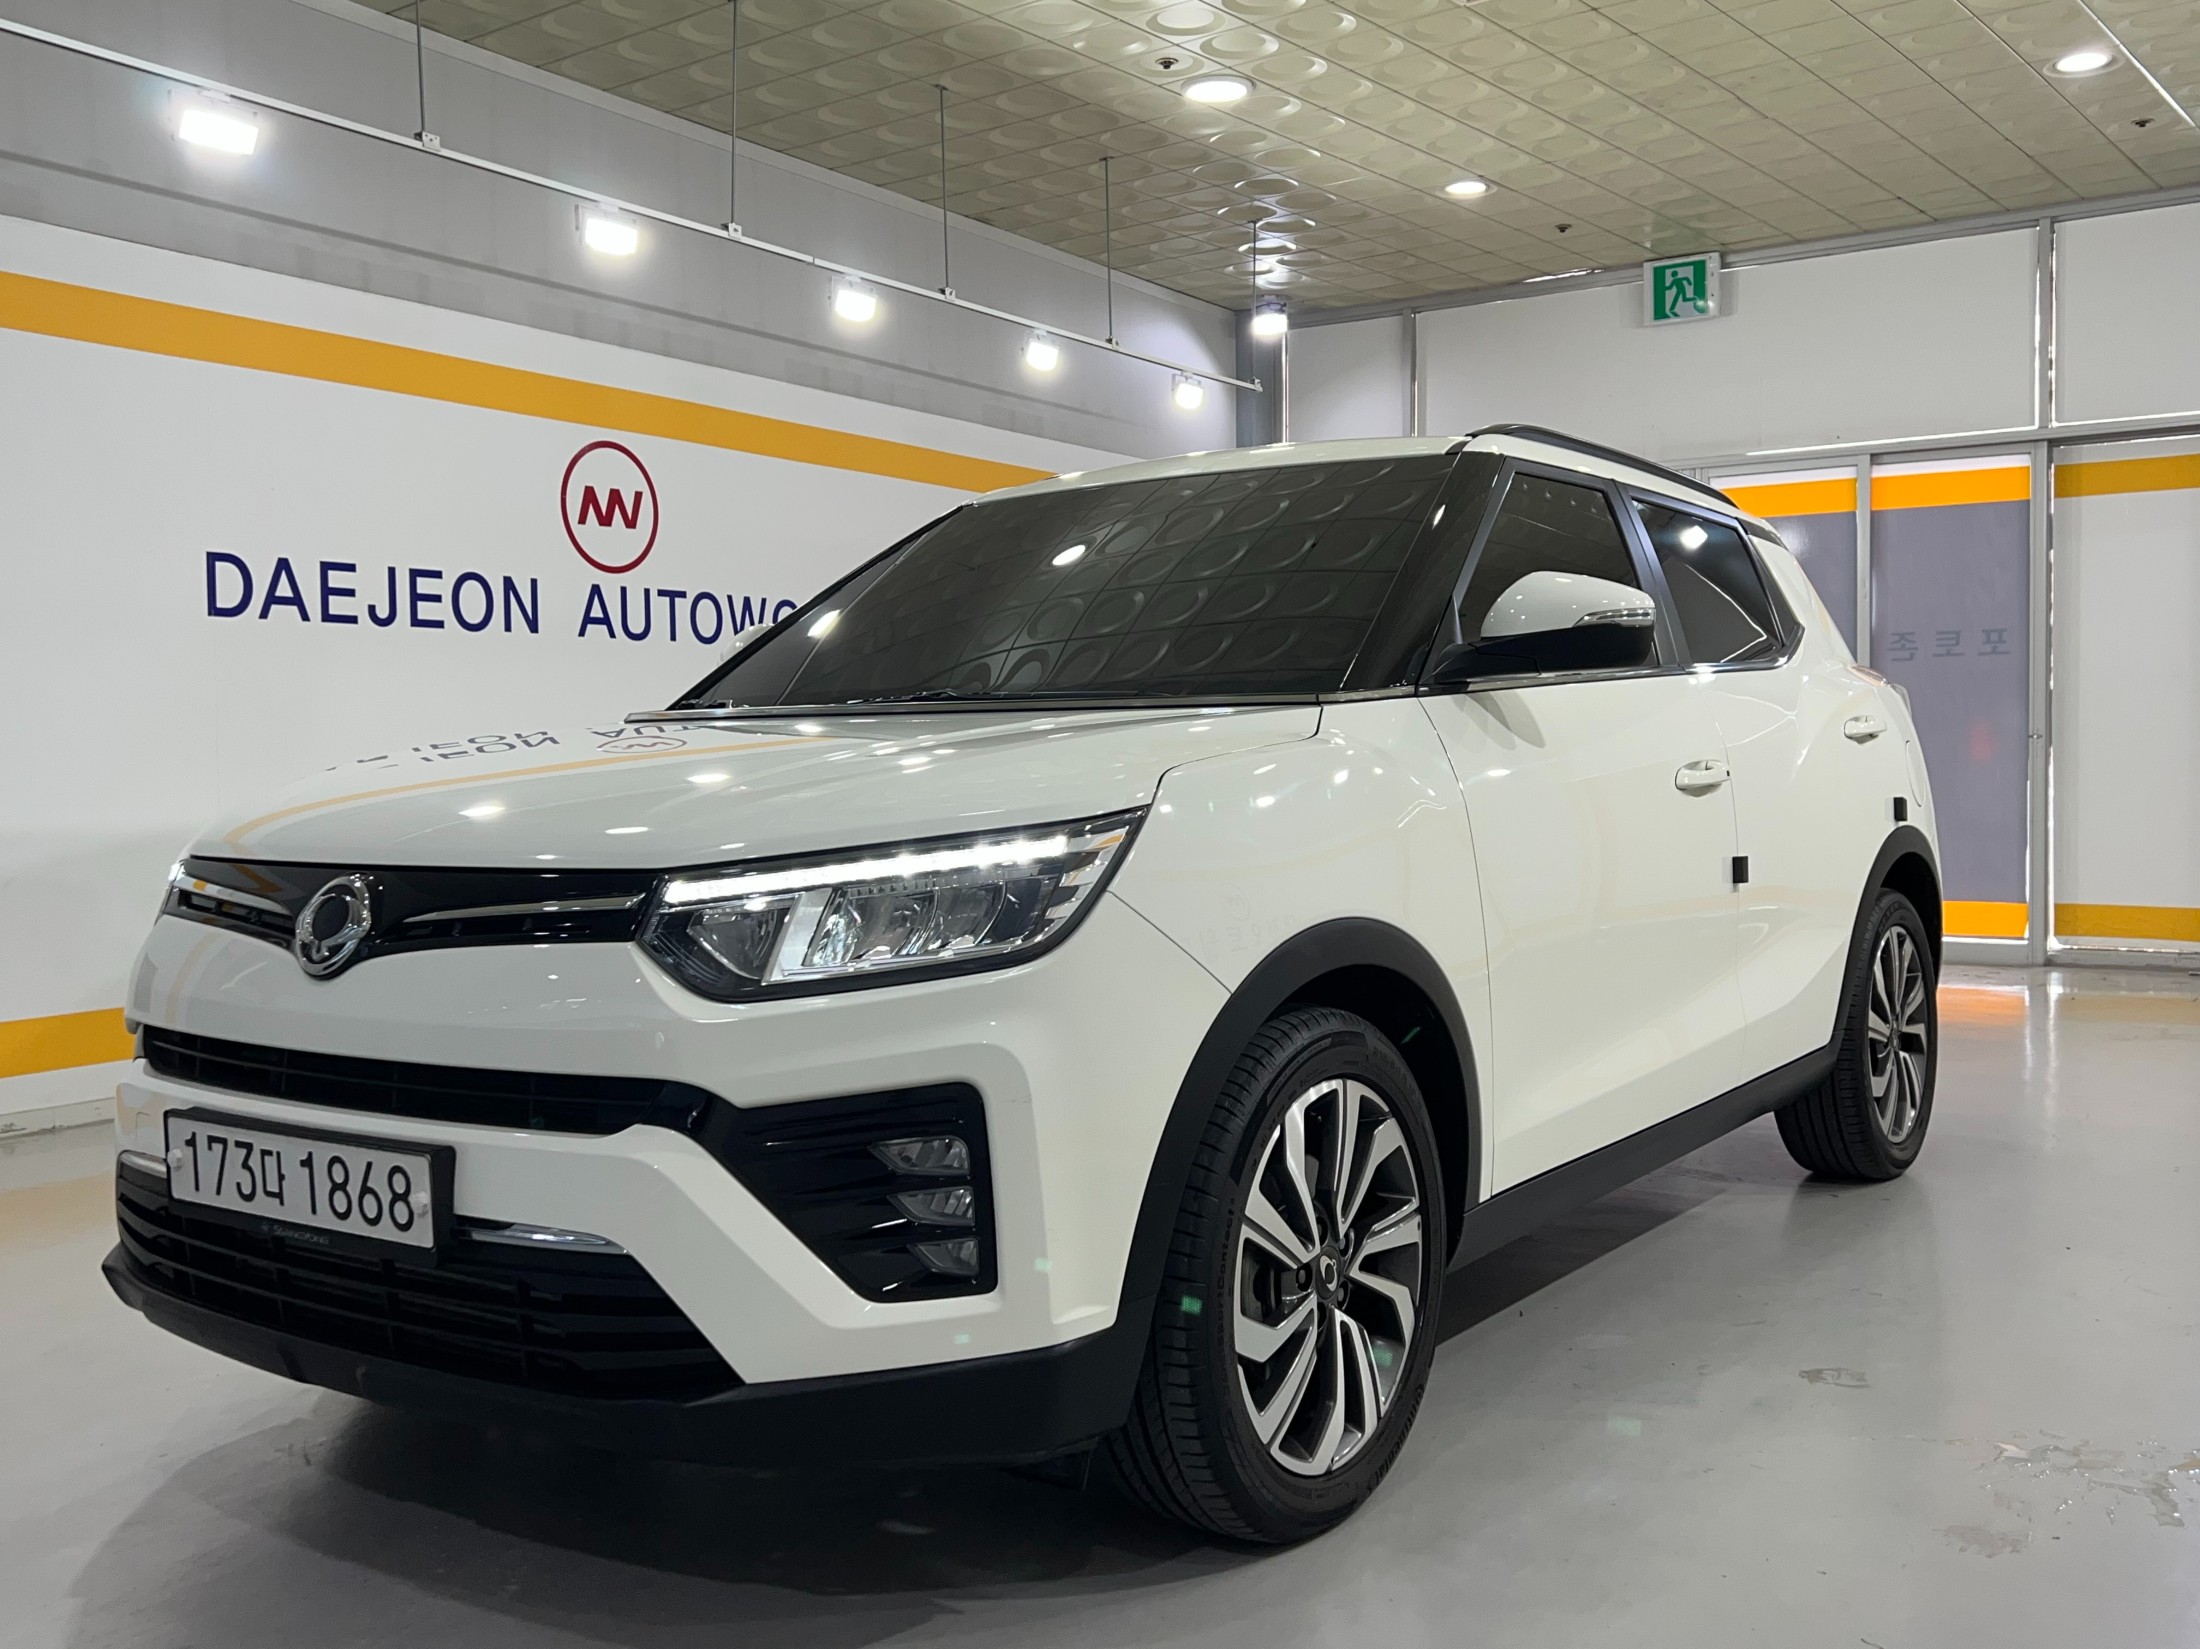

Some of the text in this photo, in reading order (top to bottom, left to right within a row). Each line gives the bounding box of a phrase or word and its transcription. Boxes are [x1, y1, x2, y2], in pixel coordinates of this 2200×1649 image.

[205, 550, 541, 635] DAEJEON
[185, 1131, 415, 1233] 173다 1868
